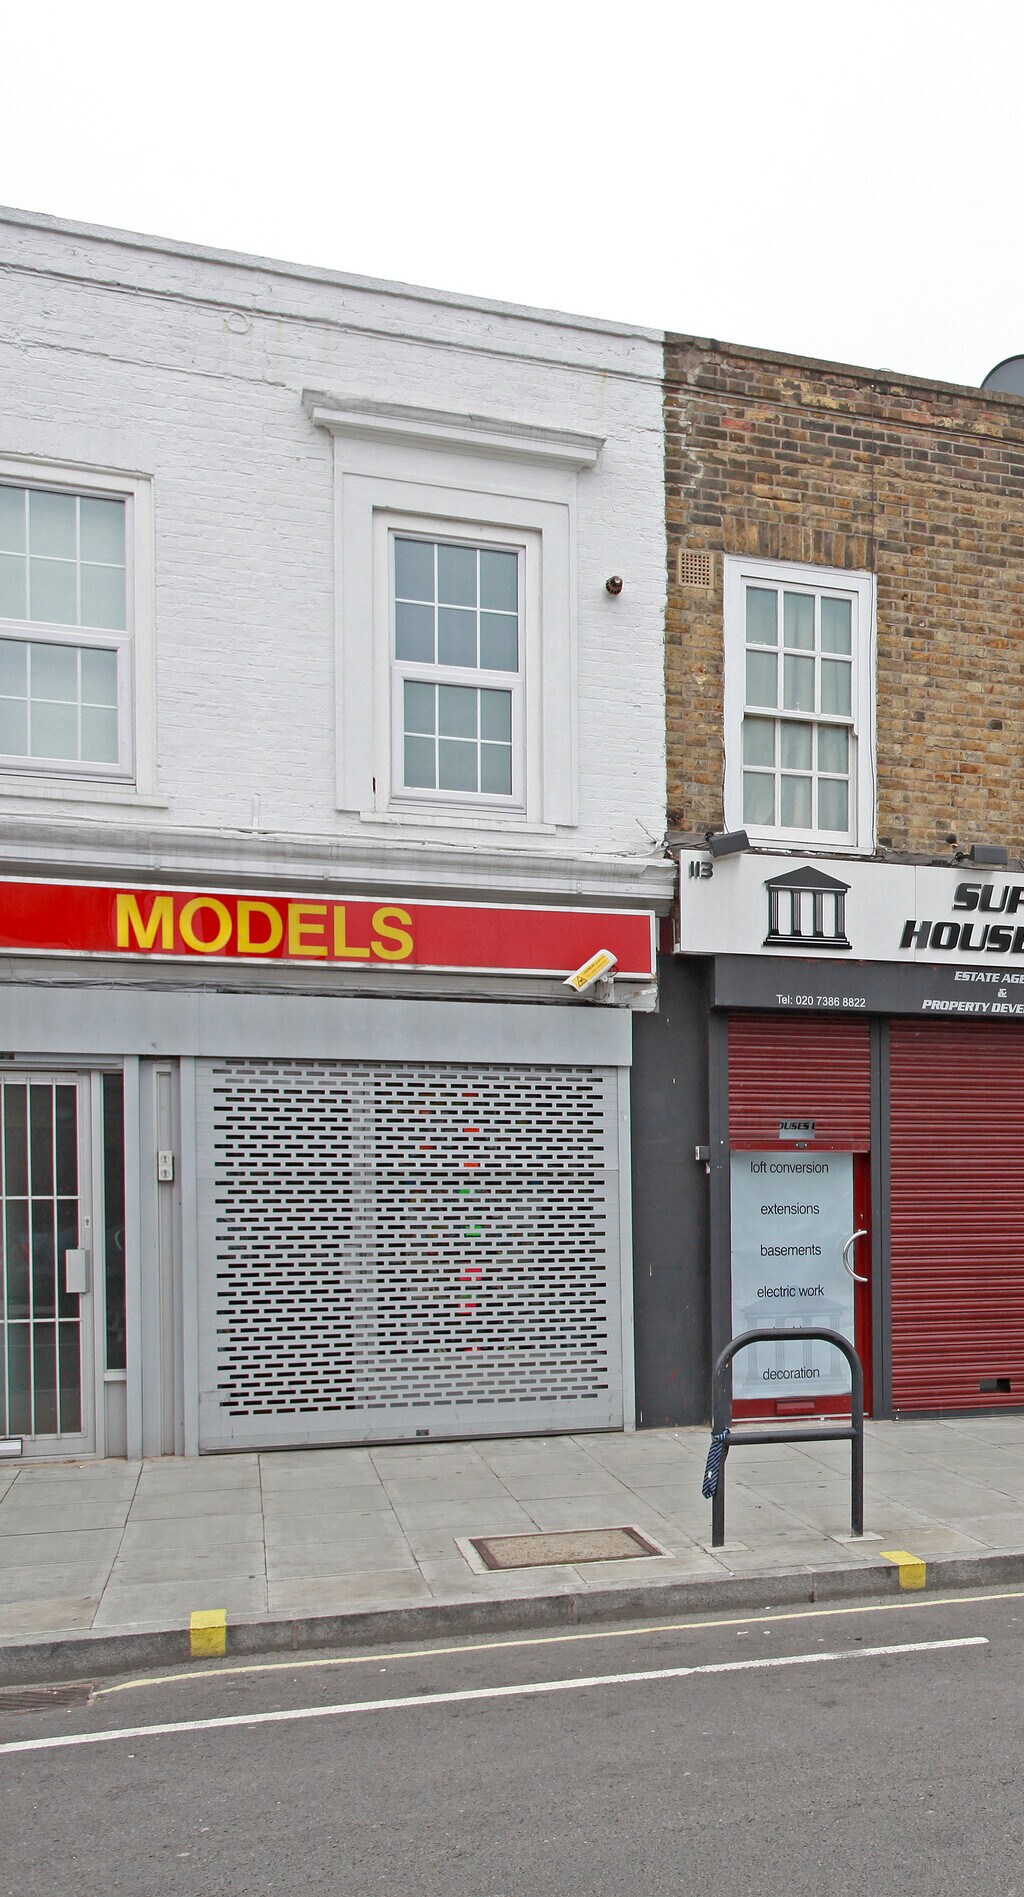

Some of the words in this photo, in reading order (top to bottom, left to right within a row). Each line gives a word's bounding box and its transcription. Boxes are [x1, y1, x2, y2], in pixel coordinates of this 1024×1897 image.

[116, 893, 414, 961] MODELS
[954, 971, 1000, 983] ESTATE
[997, 988, 1008, 998] &
[776, 993, 793, 1005] Tel:
[795, 995, 814, 1006] 020
[816, 996, 840, 1007] 7386
[842, 997, 866, 1008] 8822
[921, 999, 991, 1013] PROPERTY
[750, 1161, 767, 1173] loft
[769, 1161, 829, 1174] conversion
[760, 1203, 820, 1215] extensions
[760, 1244, 822, 1256] basements
[757, 1285, 796, 1298] electric
[798, 1284, 825, 1297] work
[762, 1366, 820, 1380] decoration
